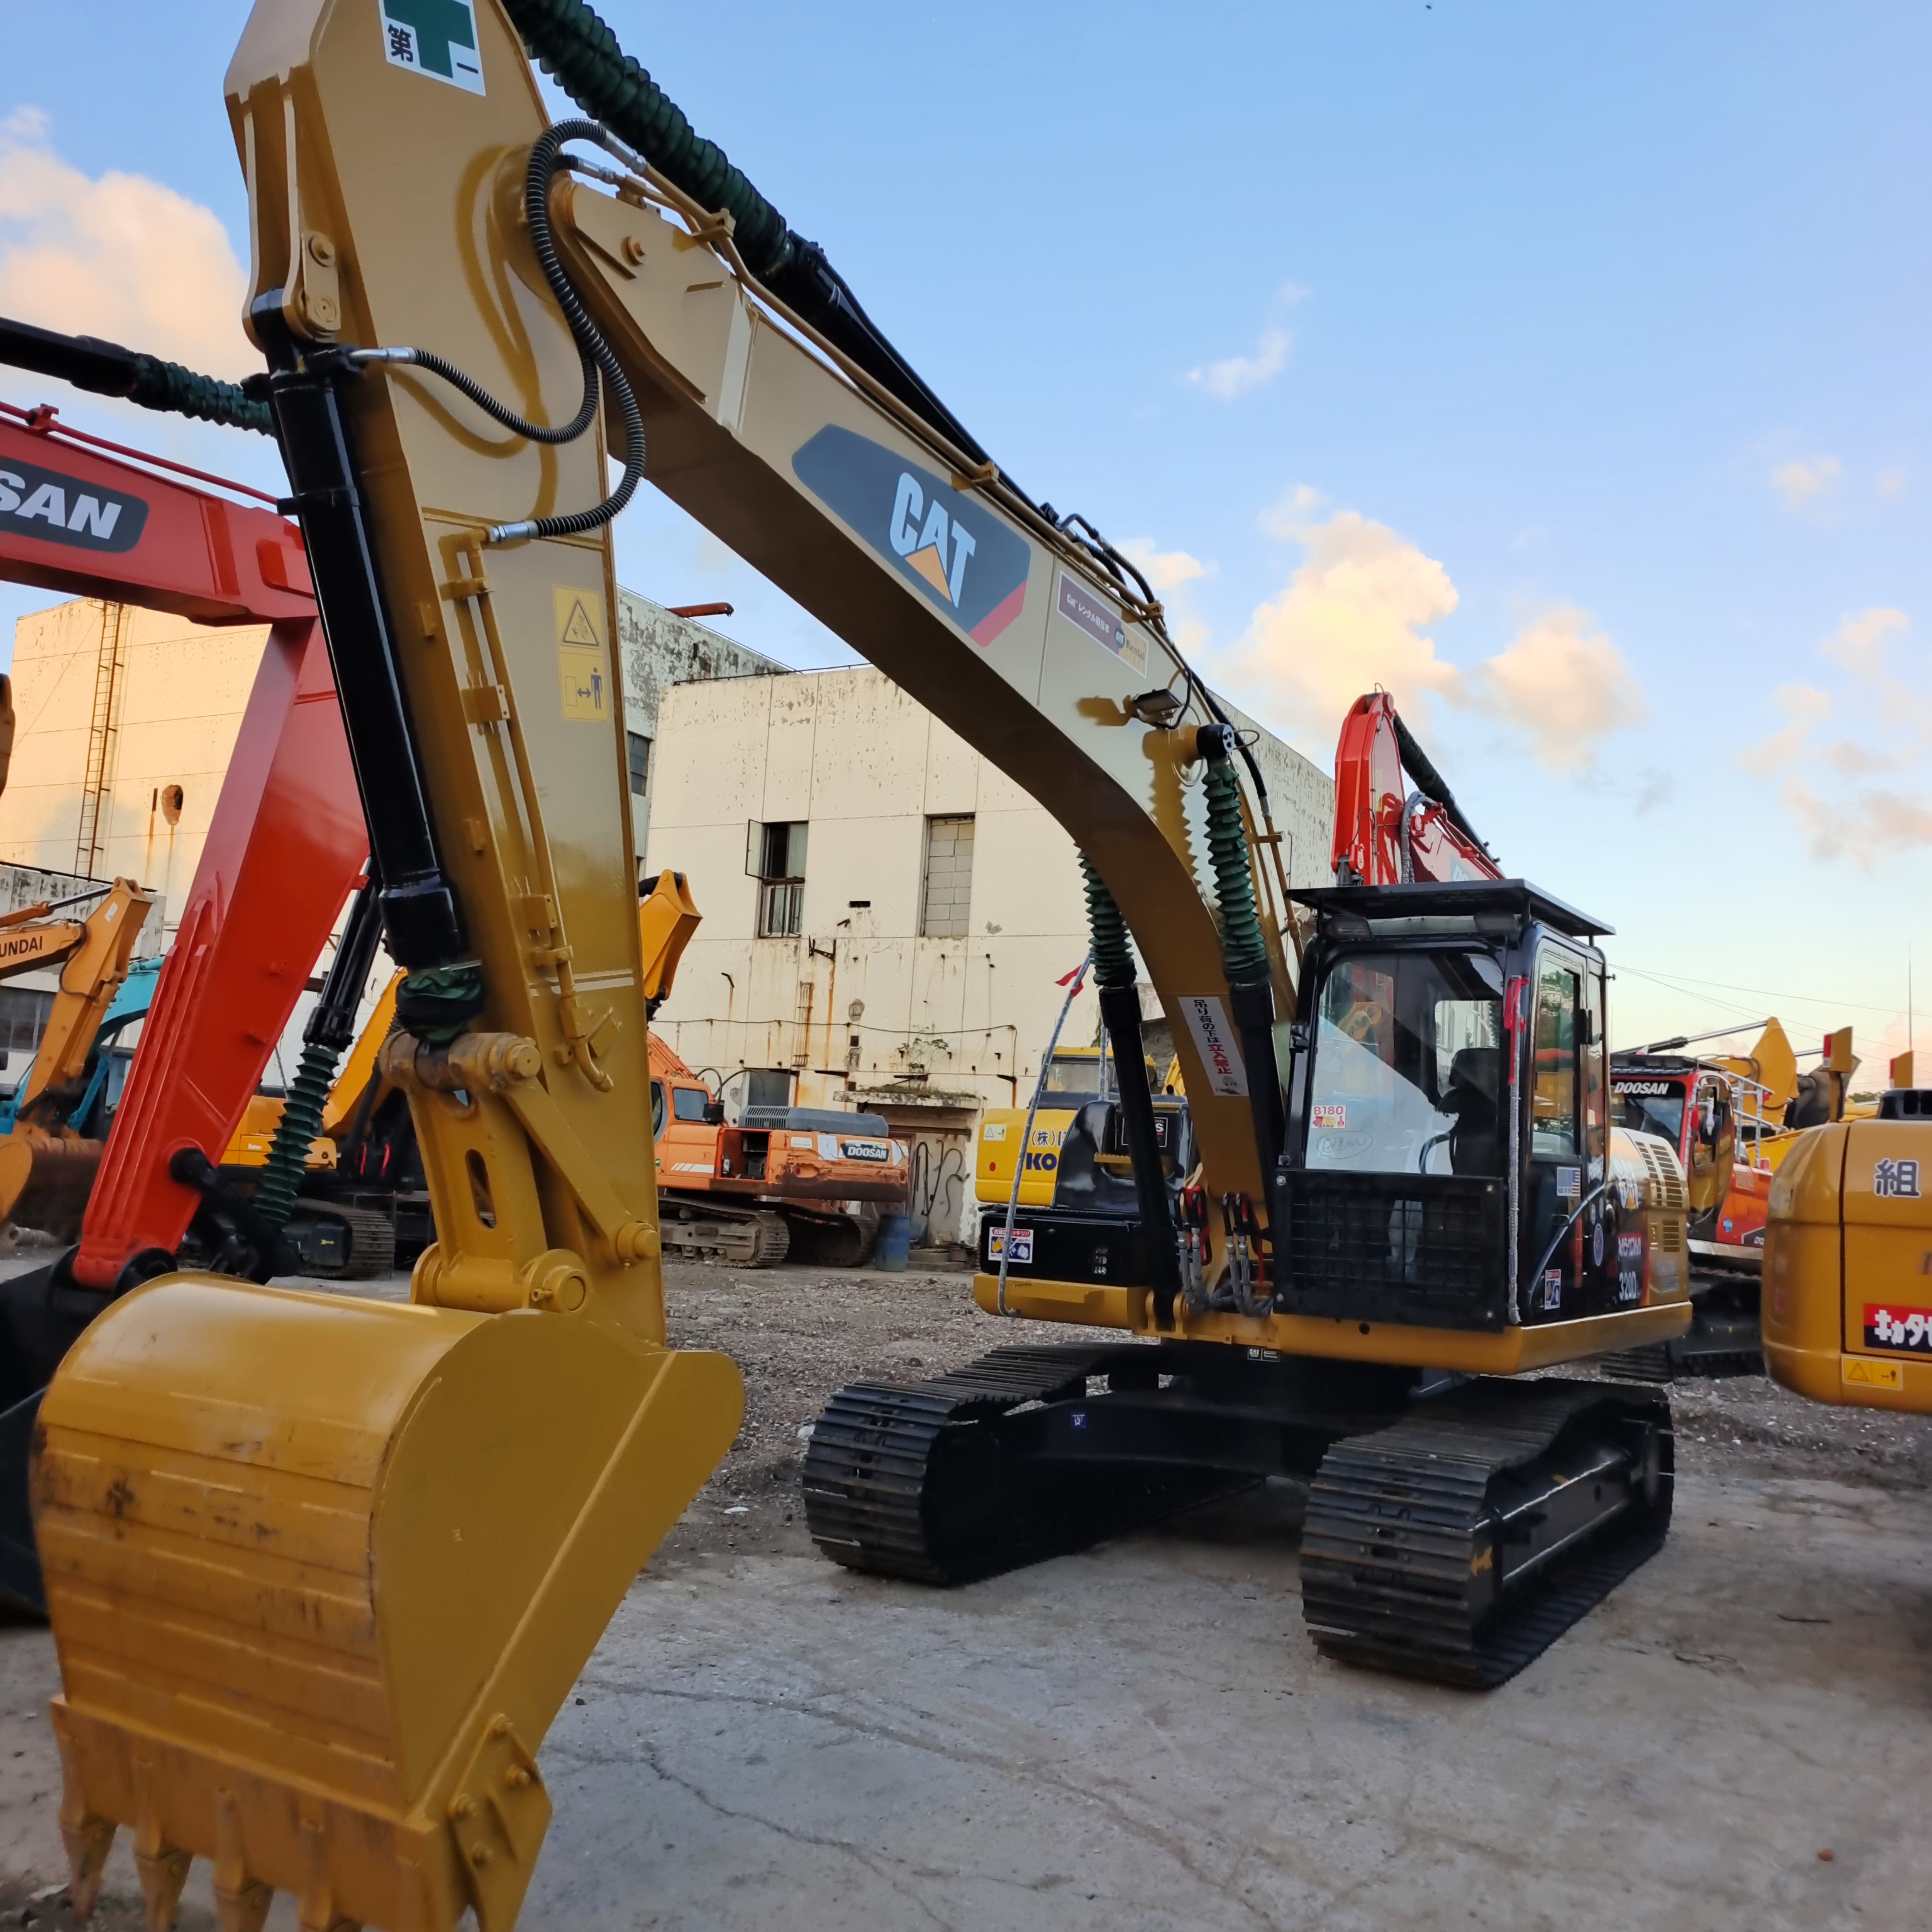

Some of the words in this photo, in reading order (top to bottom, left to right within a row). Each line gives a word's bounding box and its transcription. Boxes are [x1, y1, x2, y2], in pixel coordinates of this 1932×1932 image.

[0, 470, 122, 540] SAN
[889, 472, 976, 609] CAT
[1126, 639, 1145, 661] Rental
[0, 935, 43, 958] UNDAI
[1614, 1082, 1670, 1094] DOOSAN
[1313, 1106, 1344, 1115] B180
[847, 1146, 887, 1159] DOOSAN
[1026, 1152, 1057, 1171] KO
[1874, 1158, 1921, 1198] 組
